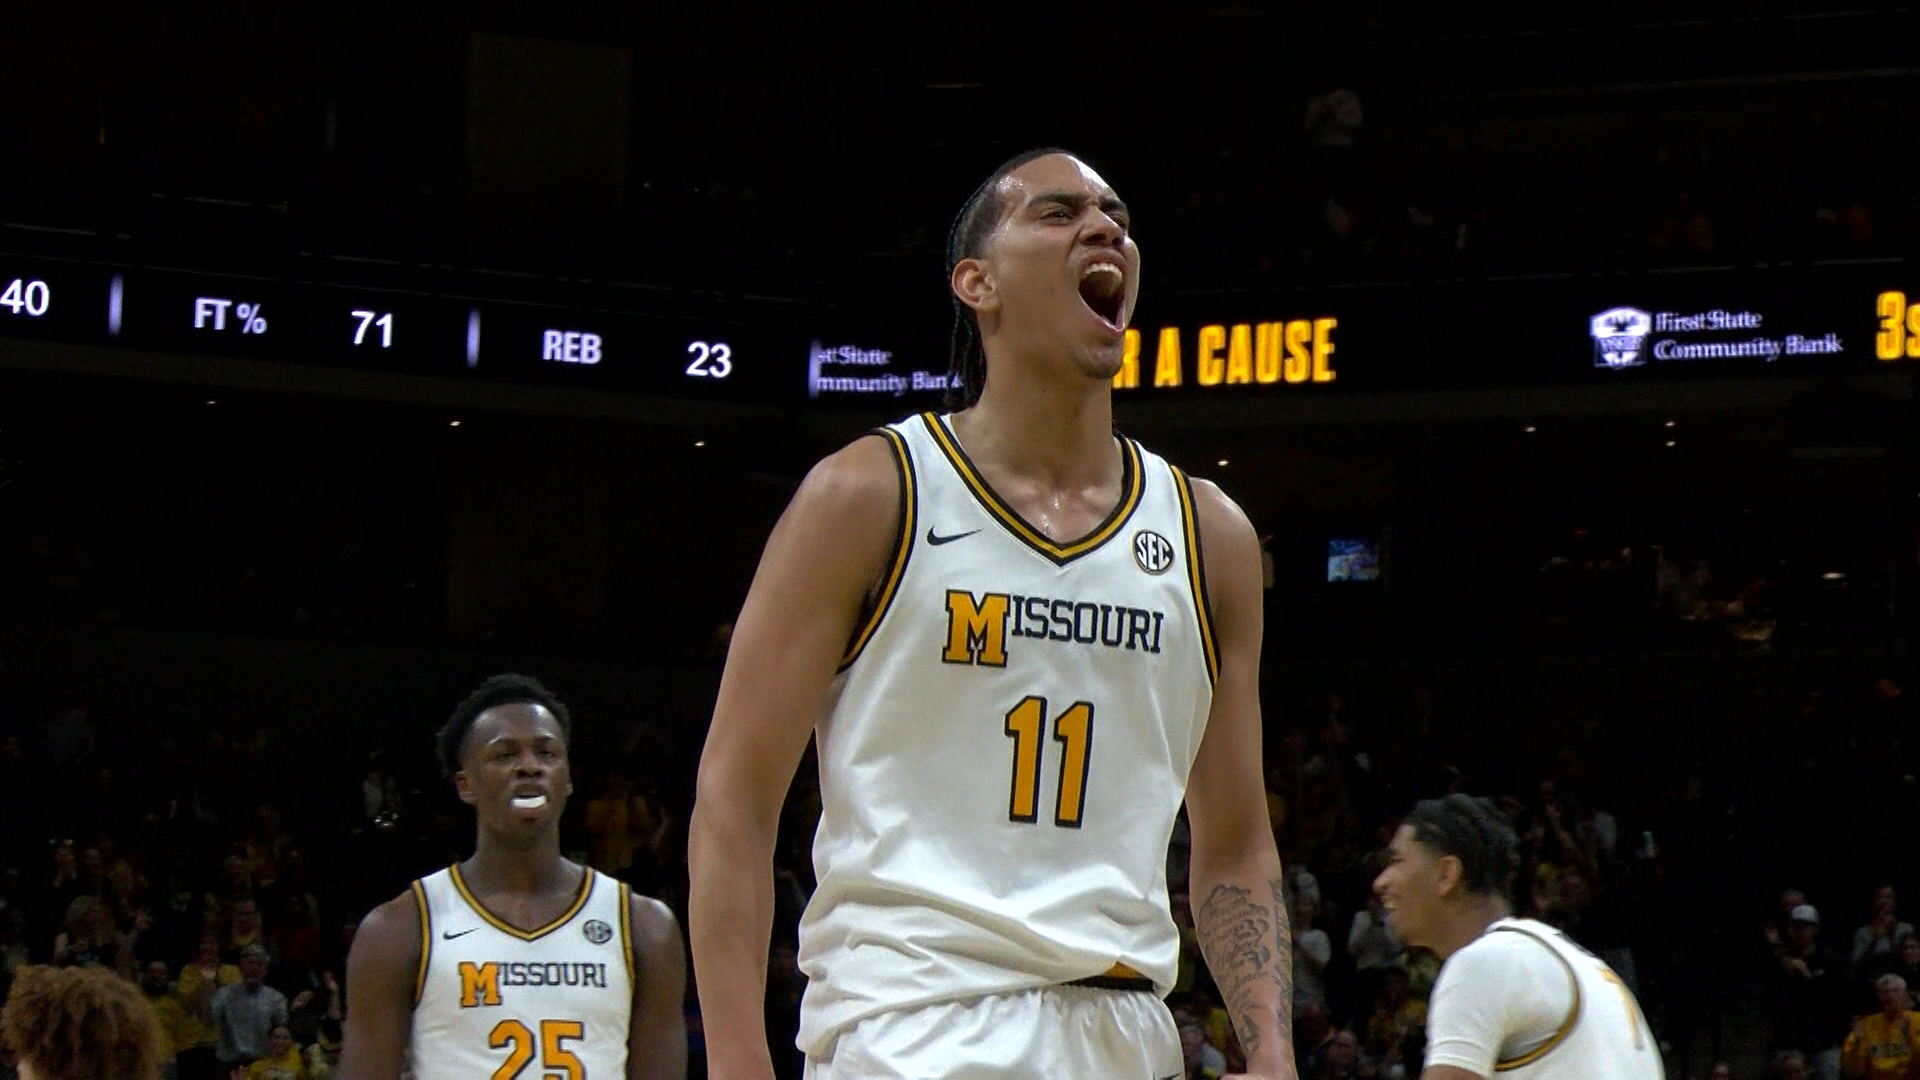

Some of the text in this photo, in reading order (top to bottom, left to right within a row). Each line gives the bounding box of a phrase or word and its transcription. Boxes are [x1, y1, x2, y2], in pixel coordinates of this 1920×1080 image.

[0, 279, 50, 316] 40
[351, 310, 393, 348] 71
[1707, 309, 1763, 331] State
[542, 329, 602, 364] REB
[685, 341, 732, 378] 23
[839, 345, 893, 365] State
[1154, 327, 1182, 388] A
[1197, 318, 1338, 386] CAUSE
[1653, 335, 1783, 362] Community
[1785, 332, 1844, 355] Bank
[1136, 532, 1171, 571] SEC
[942, 589, 1164, 667] MISSOURI
[1005, 696, 1094, 828] 11
[458, 961, 608, 1009] MISSOURI
[488, 1019, 586, 1080] 25
